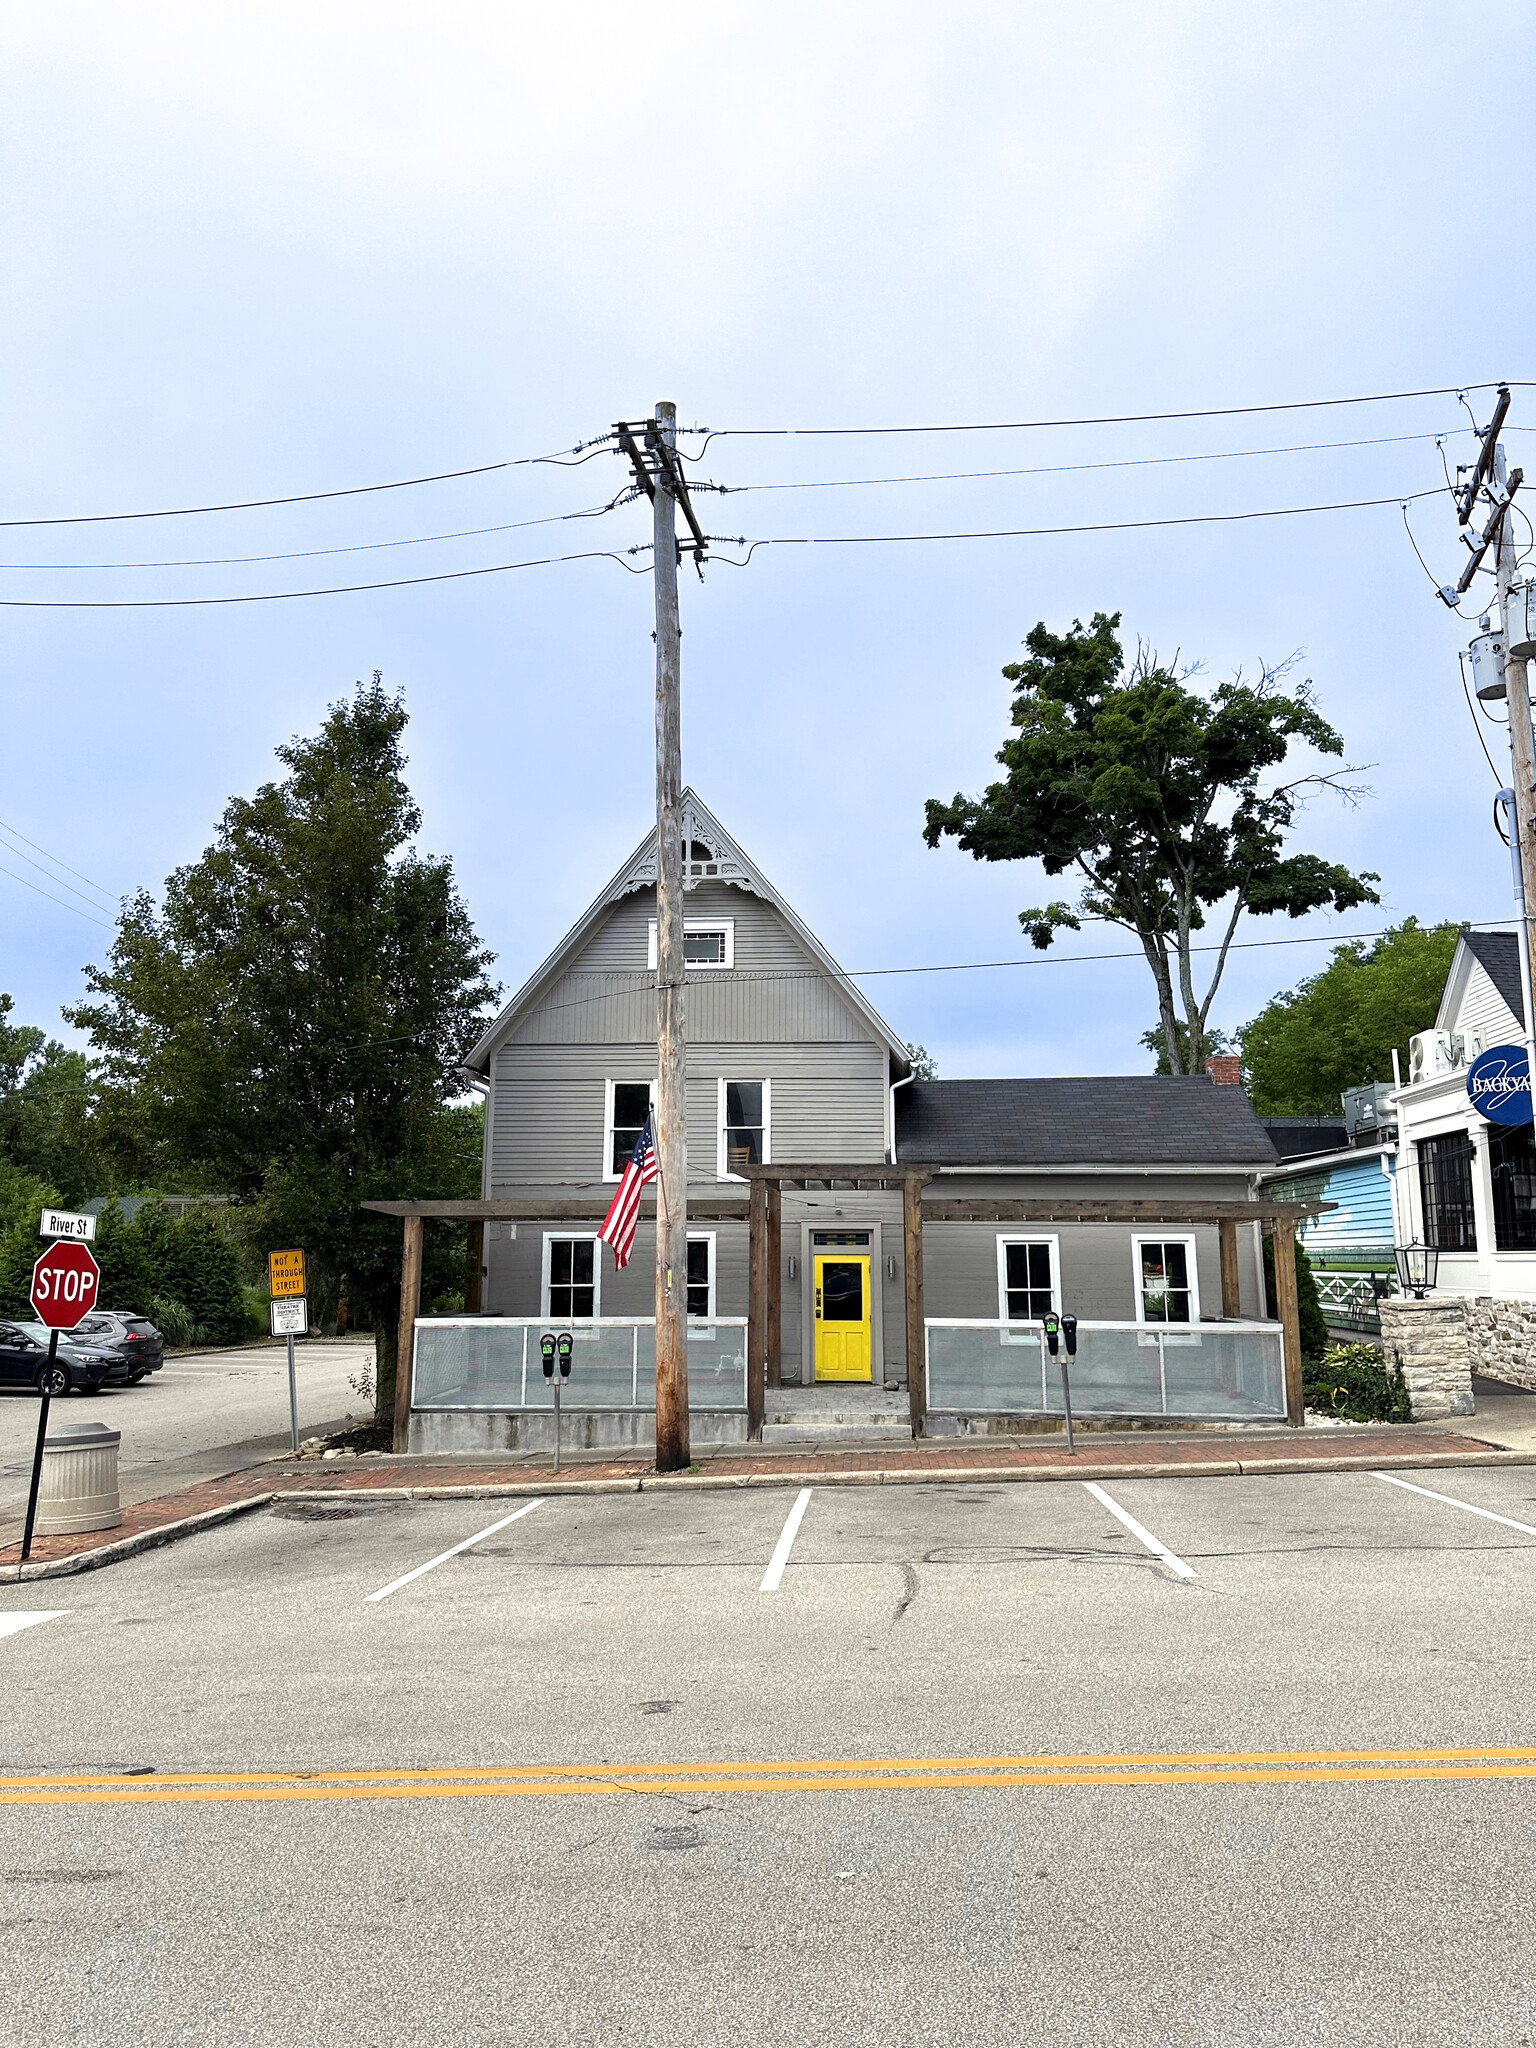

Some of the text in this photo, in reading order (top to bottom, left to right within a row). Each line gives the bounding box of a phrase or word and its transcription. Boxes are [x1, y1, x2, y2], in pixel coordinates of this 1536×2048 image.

[1472, 1076, 1531, 1093] BACKYA
[50, 1215, 87, 1235] River St
[274, 1256, 299, 1266] NOT A
[272, 1268, 303, 1278] THROUGH
[36, 1267, 95, 1302] STOP
[276, 1280, 300, 1291] STREET
